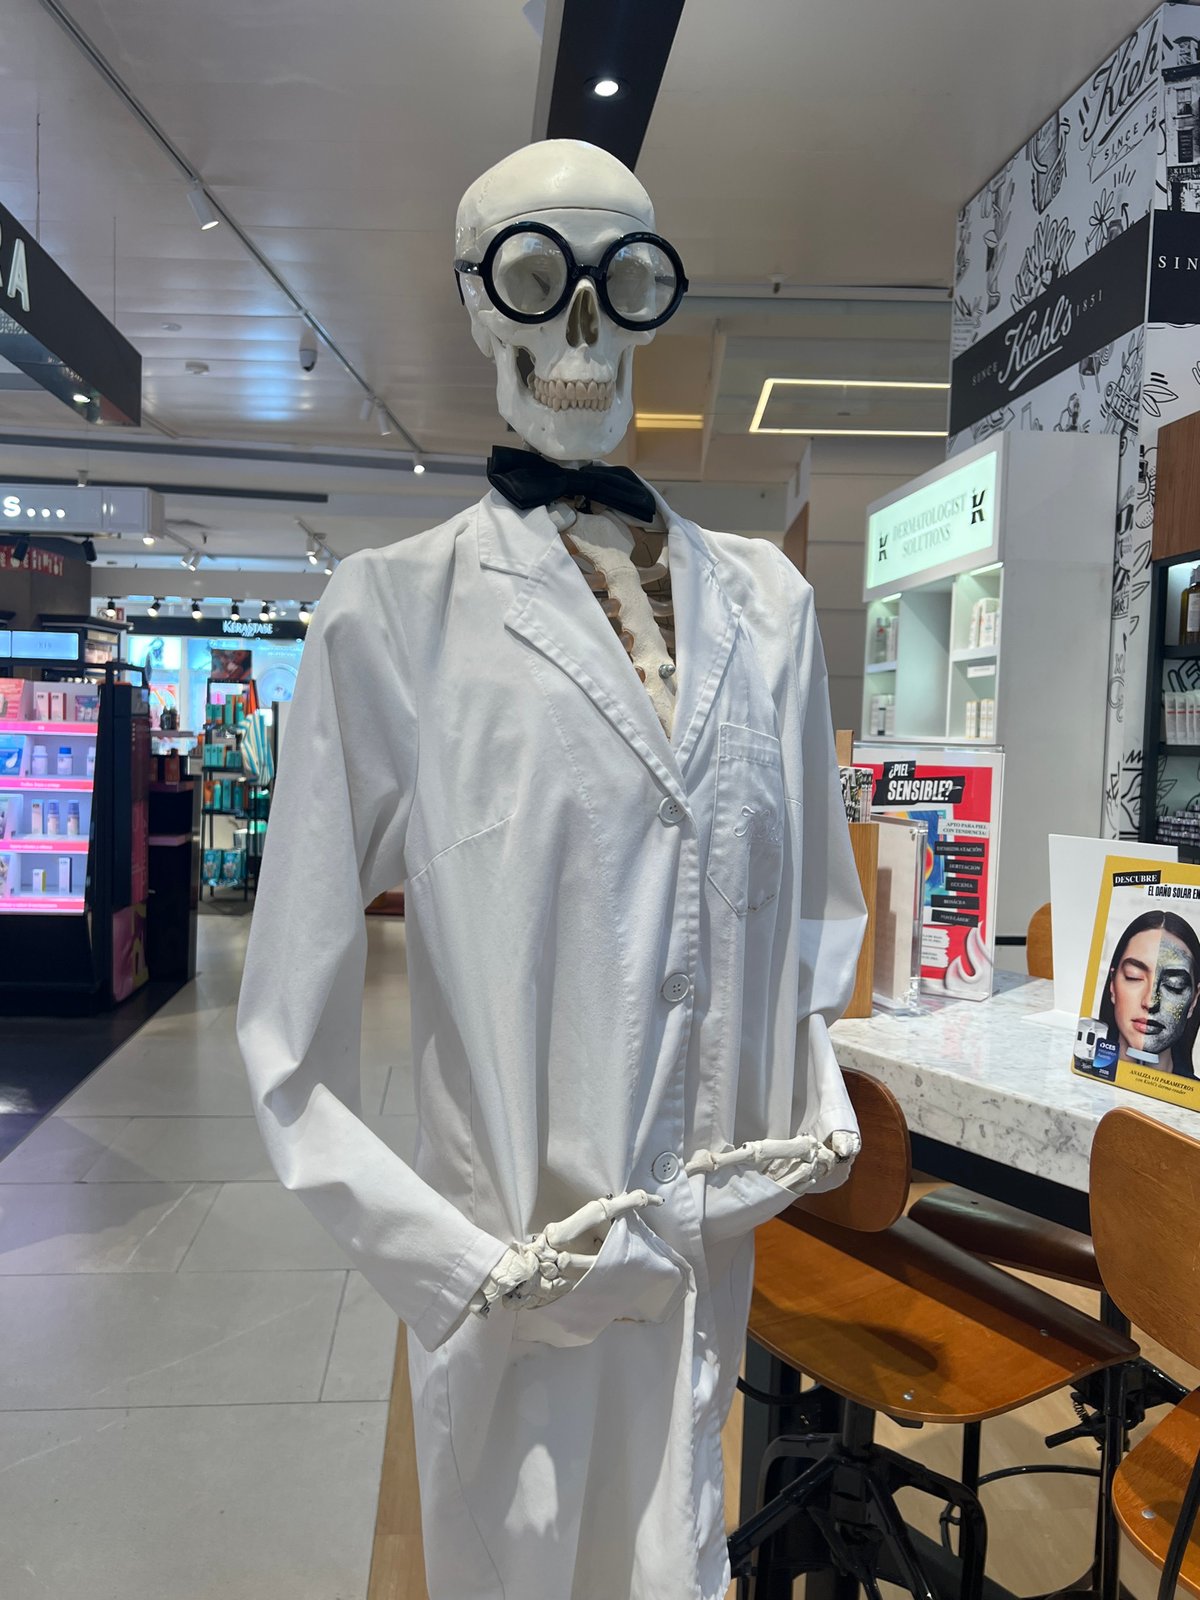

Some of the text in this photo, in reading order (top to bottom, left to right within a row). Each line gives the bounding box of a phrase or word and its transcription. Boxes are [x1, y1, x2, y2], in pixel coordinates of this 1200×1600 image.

[1104, 122, 1140, 161] SINCE
[998, 295, 1073, 388] Kiehl's
[1076, 289, 1103, 317] 1851
[893, 493, 968, 542] DERMATOLOGIST
[902, 523, 951, 558] SOLUTIONS
[888, 763, 909, 779] ¿PIEL
[887, 780, 954, 801] SENSIBLE?
[1115, 874, 1158, 884] DESCUBRE
[1147, 885, 1155, 897] EL
[1155, 884, 1172, 898] DAÑO
[1172, 887, 1192, 900] SOLAR
[1130, 1069, 1151, 1081] ANALIZA
